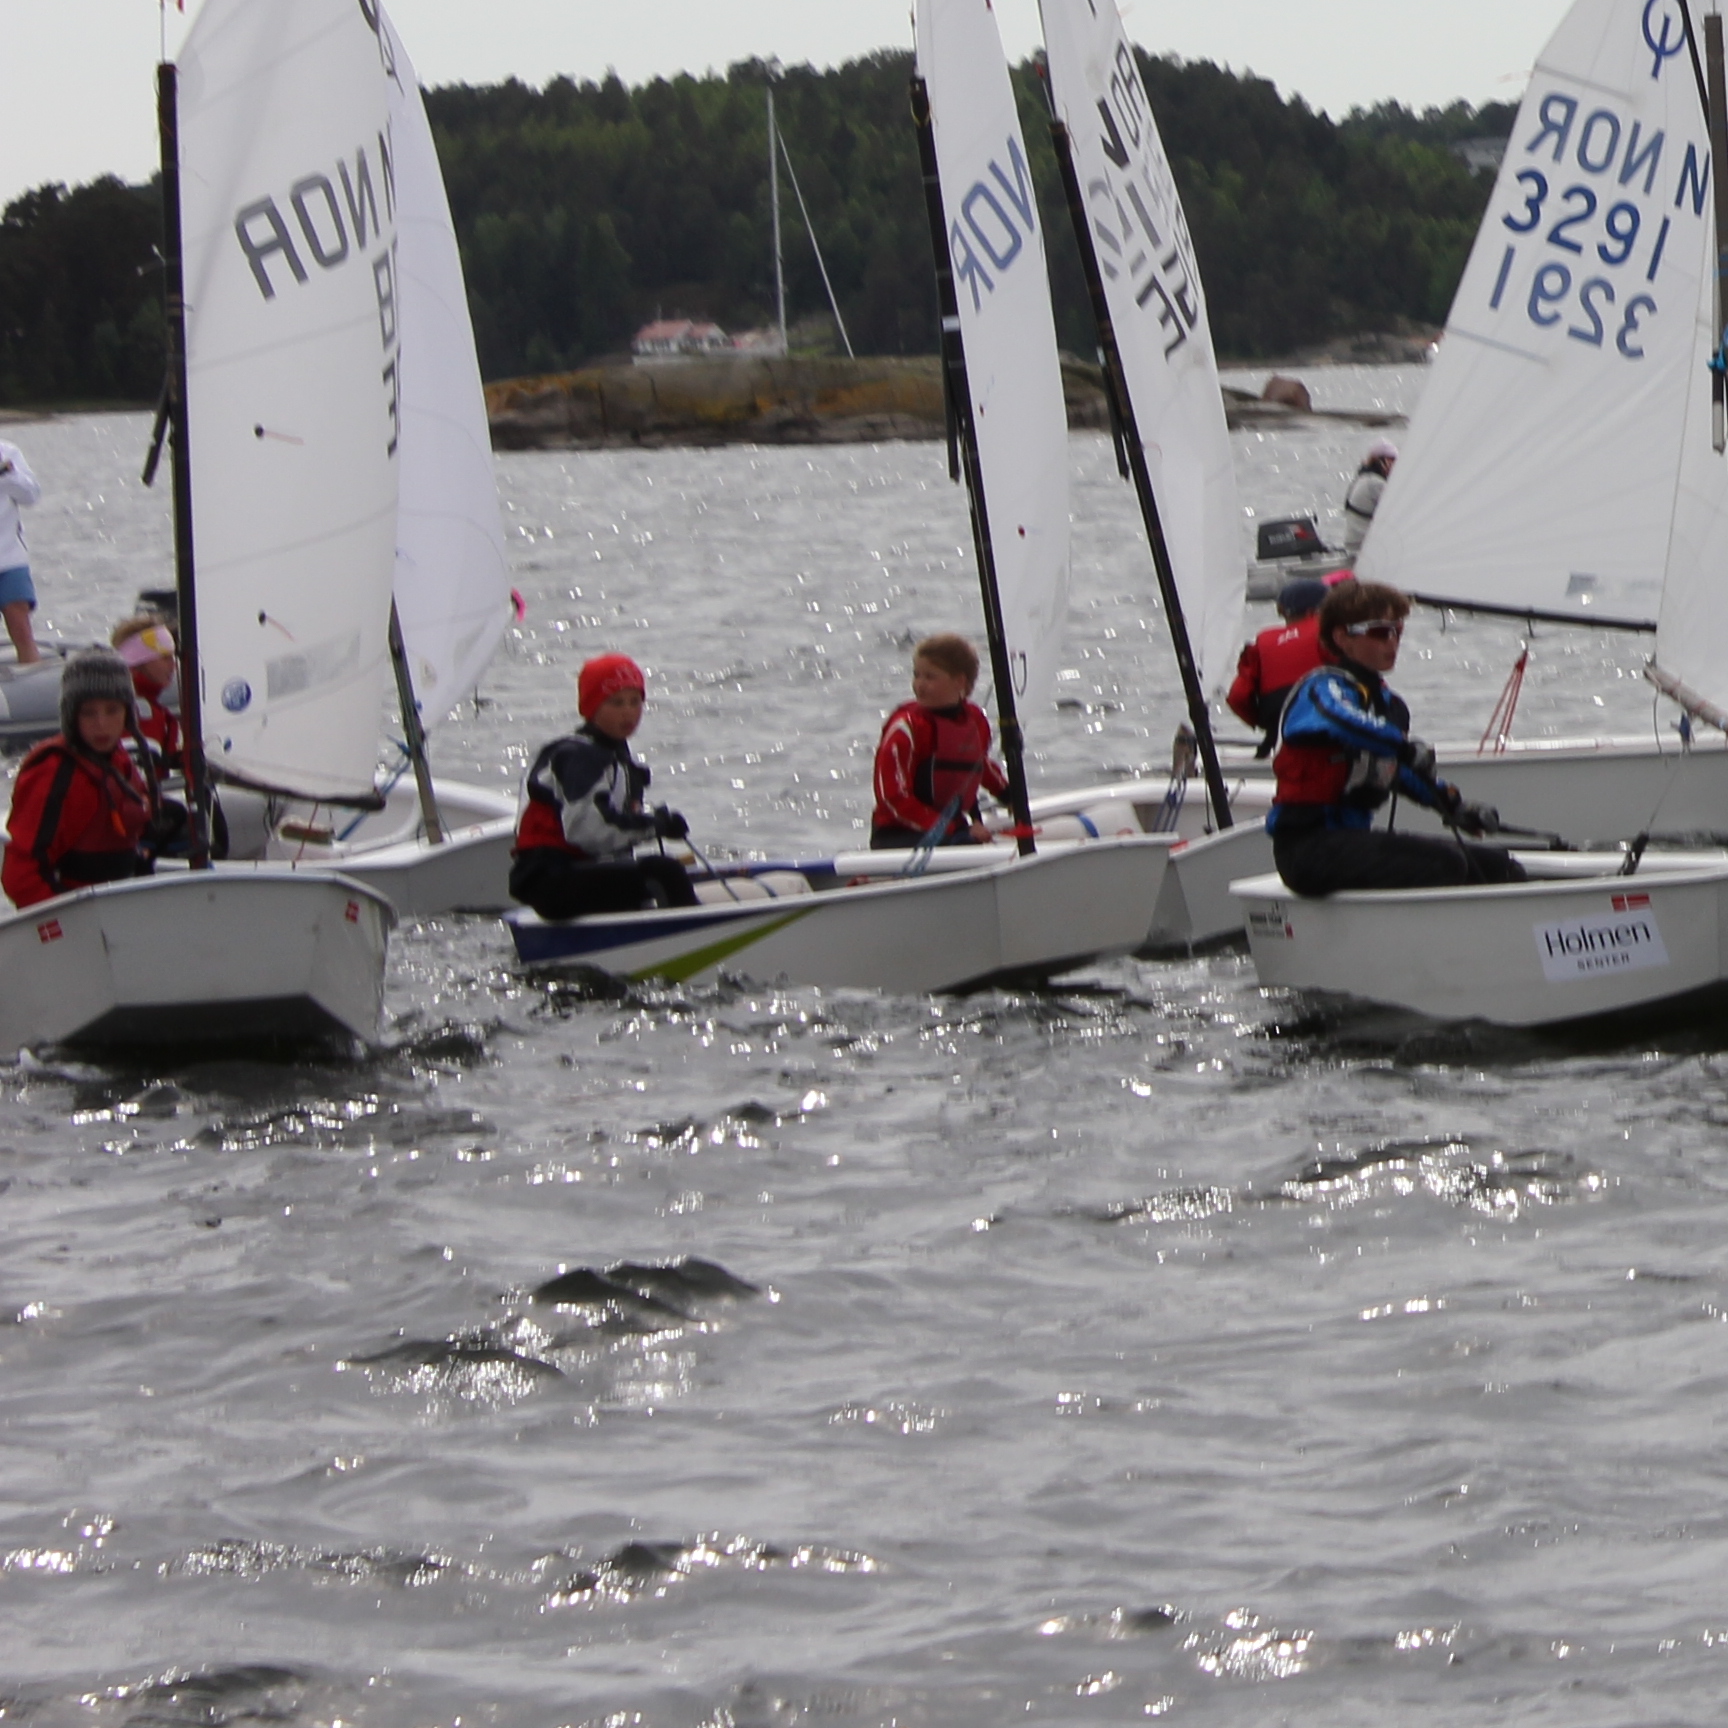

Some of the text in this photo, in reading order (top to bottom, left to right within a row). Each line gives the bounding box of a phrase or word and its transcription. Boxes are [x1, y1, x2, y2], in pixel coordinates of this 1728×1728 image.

[1502, 169, 1670, 282] 3291
[1544, 920, 1651, 959] Holmen
[1577, 952, 1630, 971] SENTER
